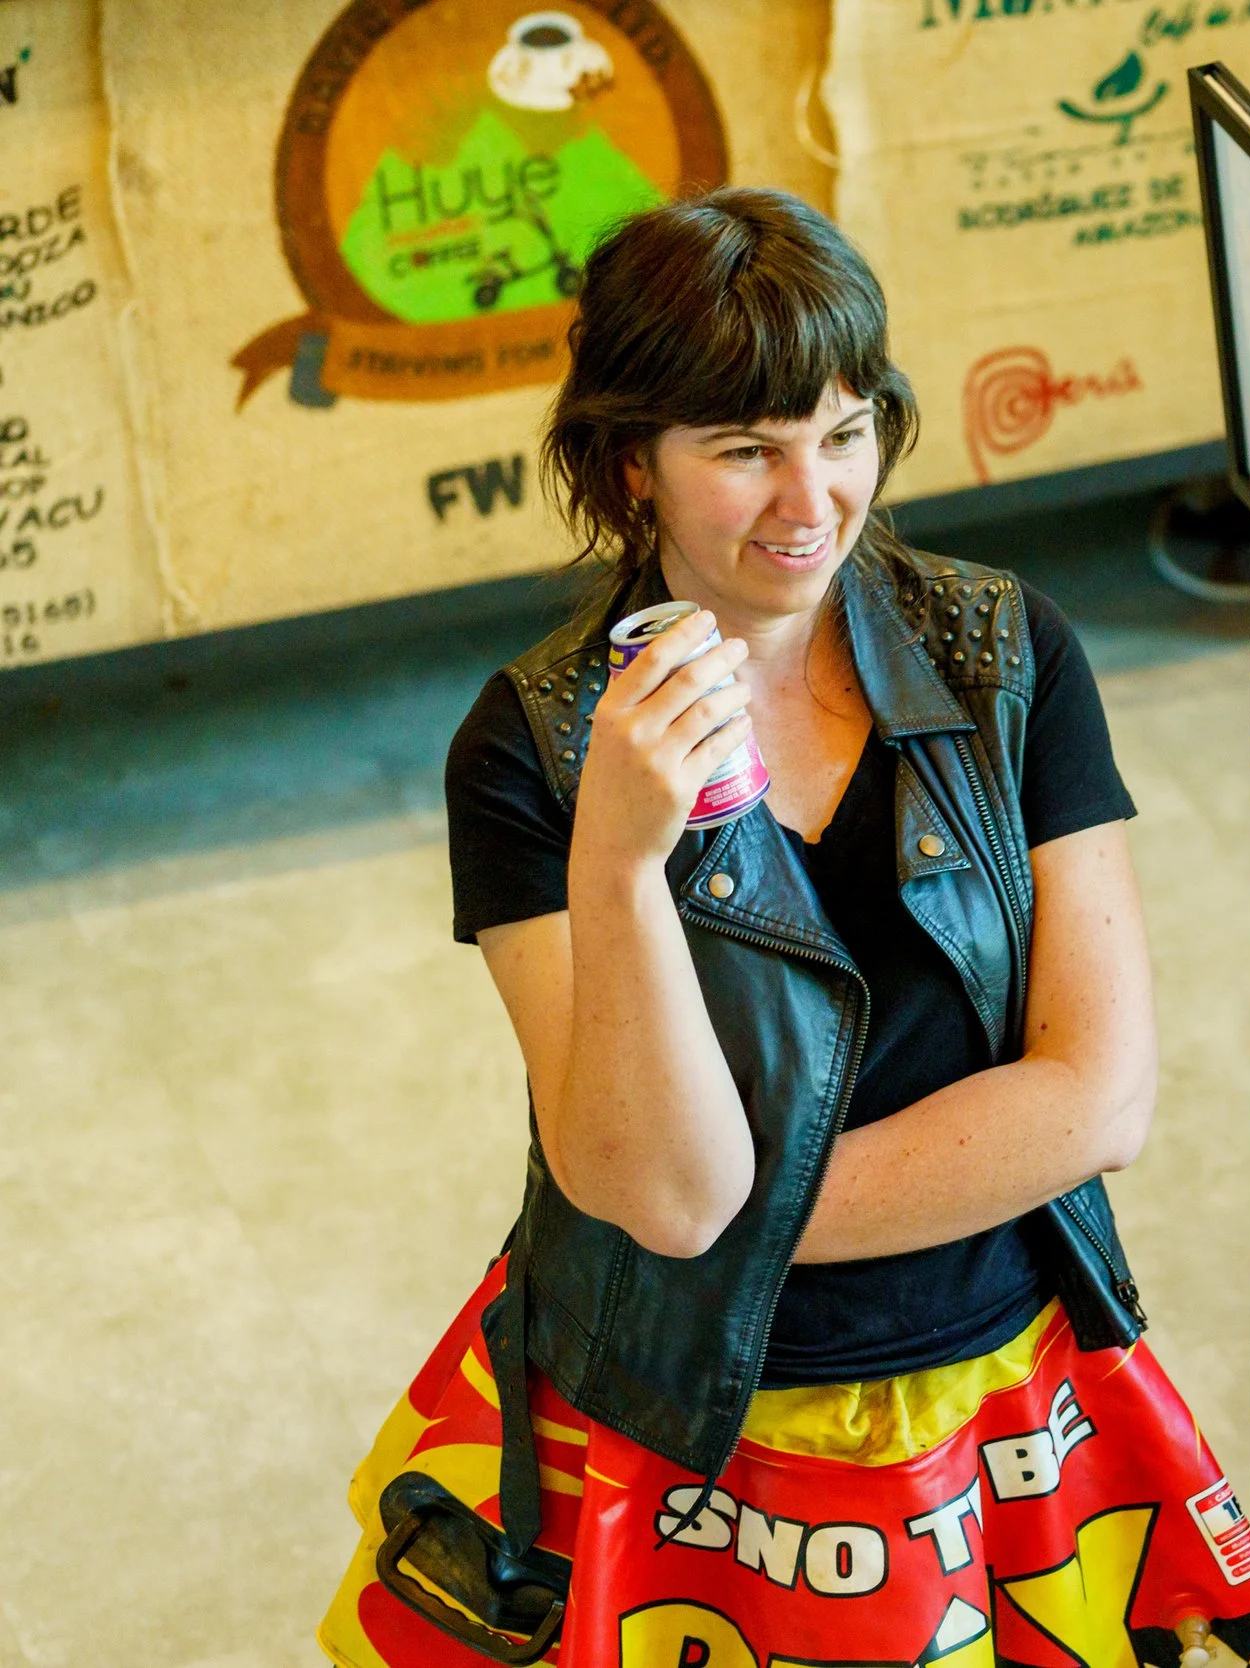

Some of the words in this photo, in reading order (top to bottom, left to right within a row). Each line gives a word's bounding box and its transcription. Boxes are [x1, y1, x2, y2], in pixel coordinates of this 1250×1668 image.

[377, 150, 561, 232] Huye
[425, 451, 526, 525] FW
[654, 1483, 889, 1599] SNO
